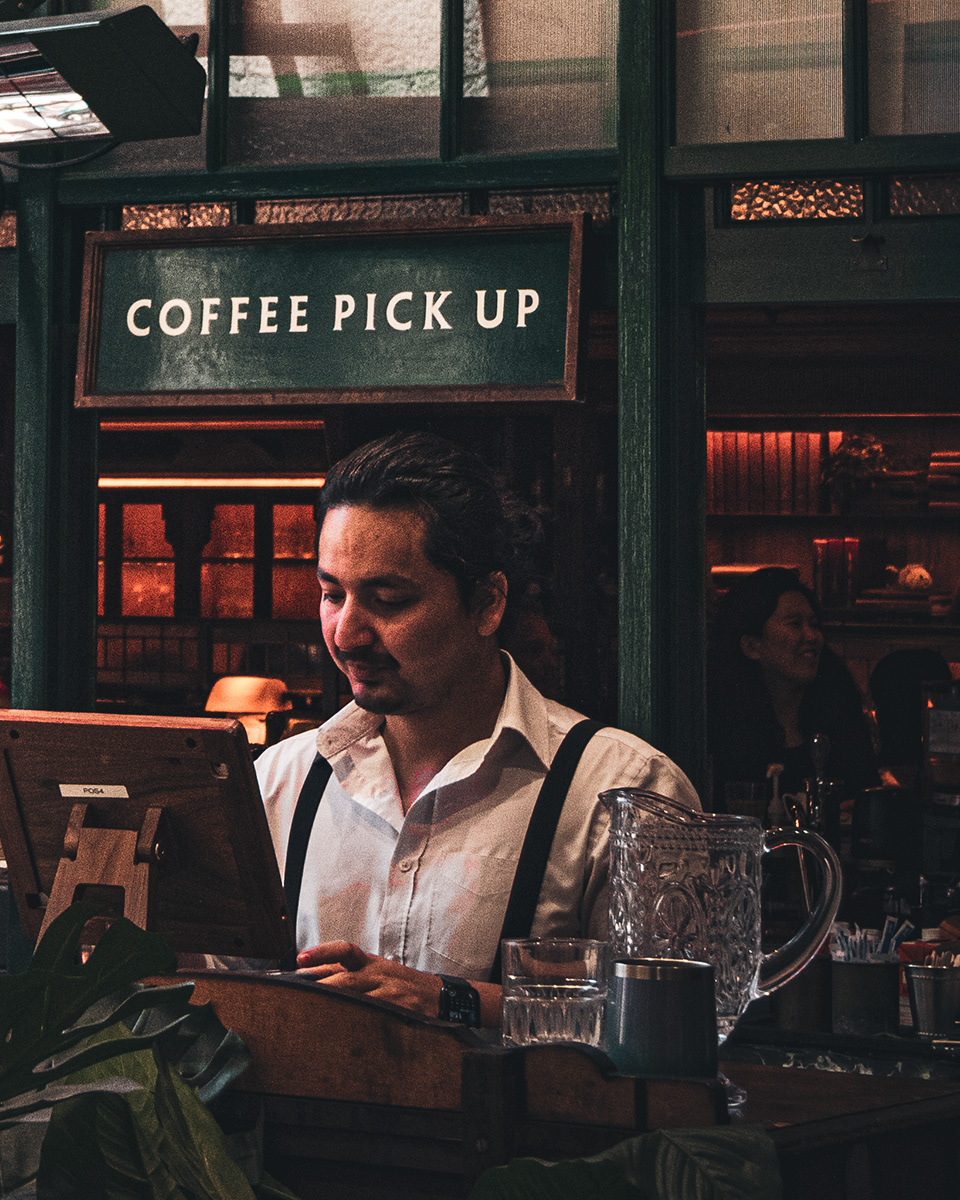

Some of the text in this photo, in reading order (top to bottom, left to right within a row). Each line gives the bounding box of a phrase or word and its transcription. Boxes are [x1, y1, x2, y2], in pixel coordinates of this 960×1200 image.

[126, 288, 540, 337] COFFEE PICK UP
